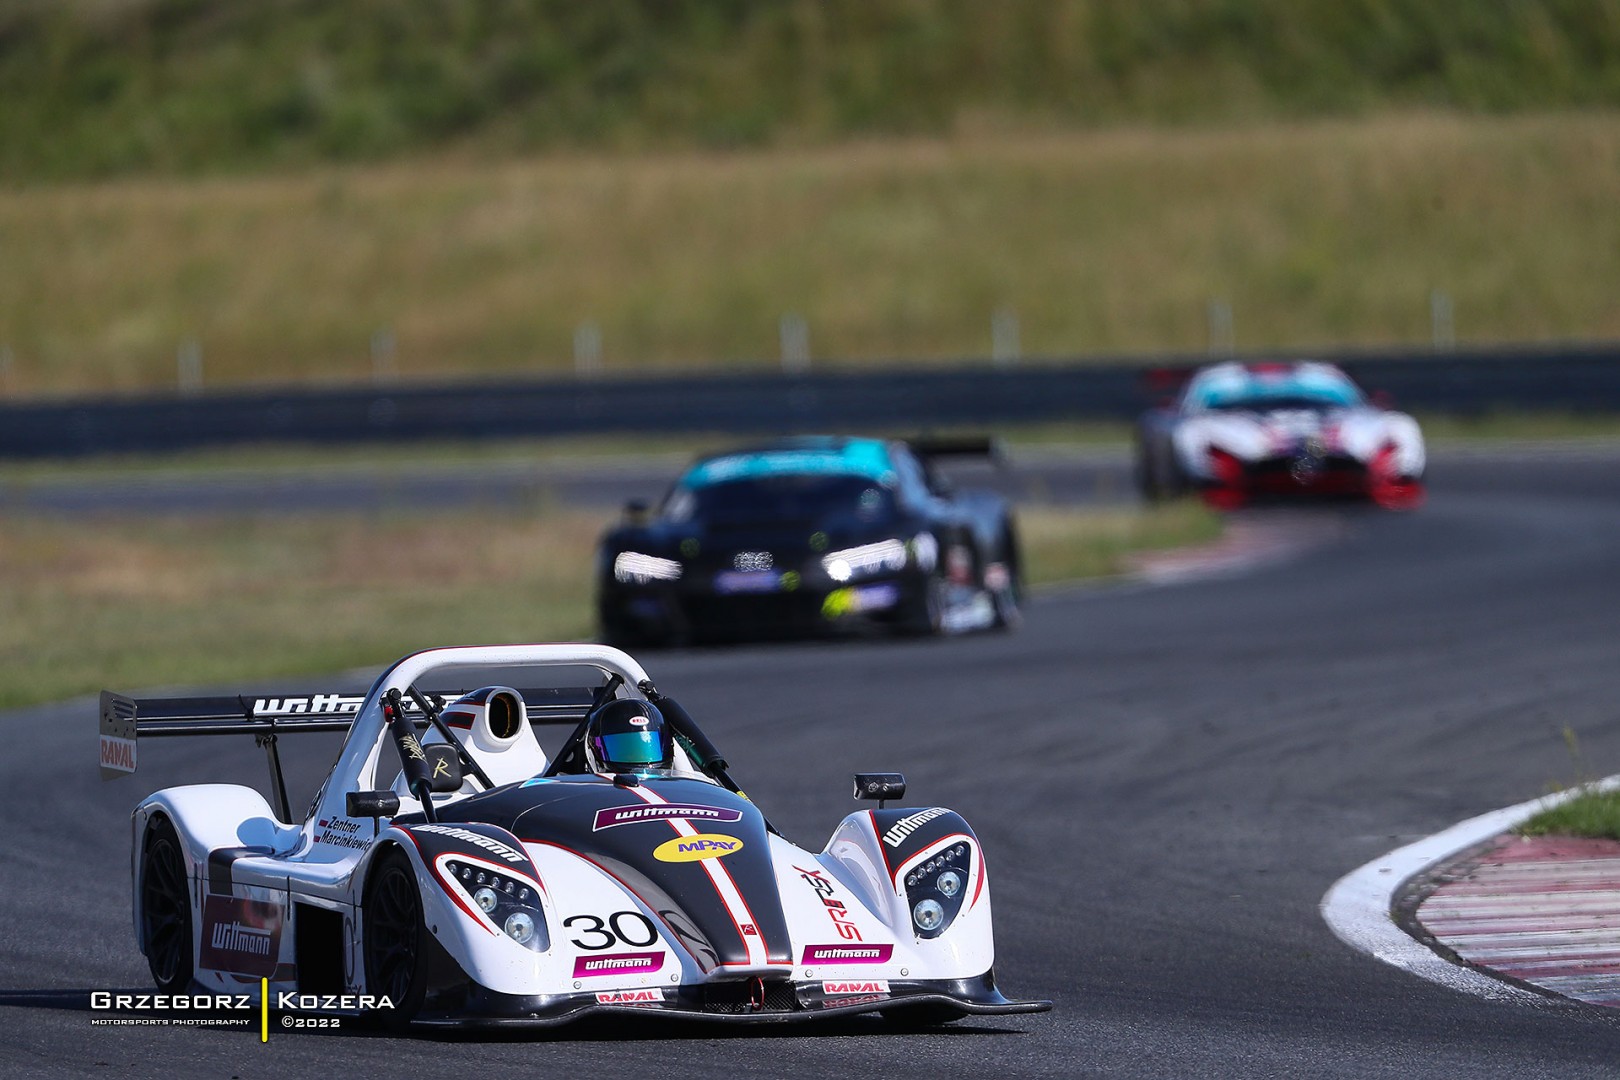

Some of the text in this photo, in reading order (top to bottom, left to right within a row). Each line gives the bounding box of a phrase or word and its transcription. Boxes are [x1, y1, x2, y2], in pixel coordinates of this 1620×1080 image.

[101, 739, 134, 769] RANAL
[327, 816, 361, 834] Zentner
[319, 830, 372, 851] Marcinkiewic
[563, 911, 658, 950] 30
[824, 982, 884, 992] RANAL
[598, 991, 659, 1003] RANAL
